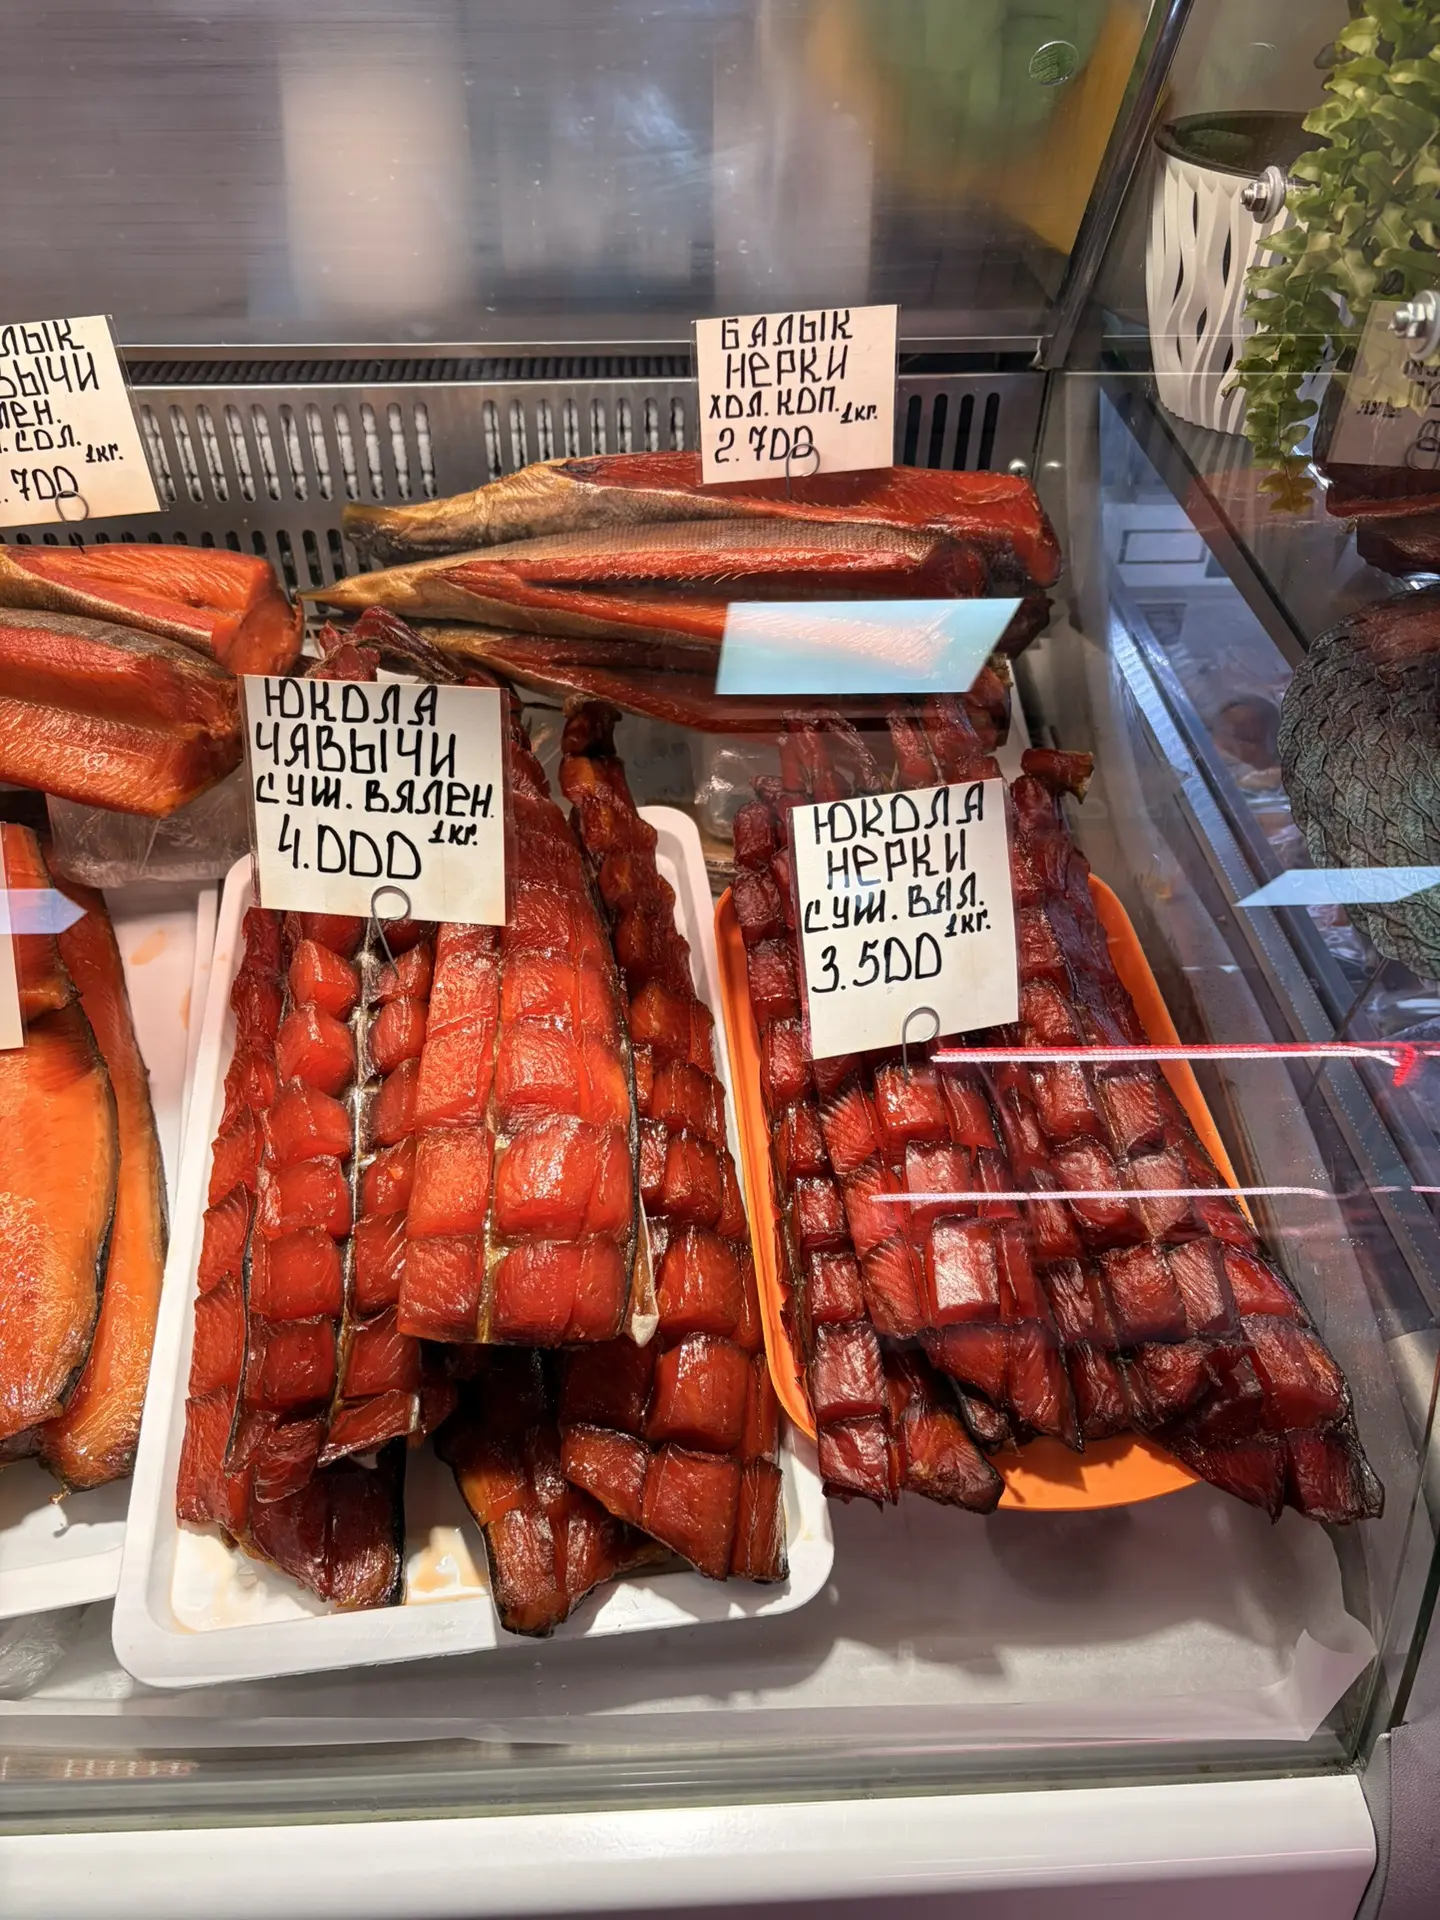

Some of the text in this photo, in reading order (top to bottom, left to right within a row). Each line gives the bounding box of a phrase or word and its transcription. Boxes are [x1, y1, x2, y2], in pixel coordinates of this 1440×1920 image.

[721, 309, 853, 350] БАЛЫК
[726, 344, 848, 389] НЕРКИ
[709, 386, 840, 419] ХОЛ. КОП.
[15, 424, 82, 452] СОЛ.
[264, 677, 438, 726] ЮКОЛА
[256, 772, 496, 818] СУШ. ВЯЛЕН.
[813, 781, 985, 845] ЮКОЛА
[278, 813, 422, 880] 4.000
[826, 828, 967, 890] НЕРКИ
[804, 872, 985, 934] СУШ. ВЯЛ.
[811, 932, 943, 994] 3.500
